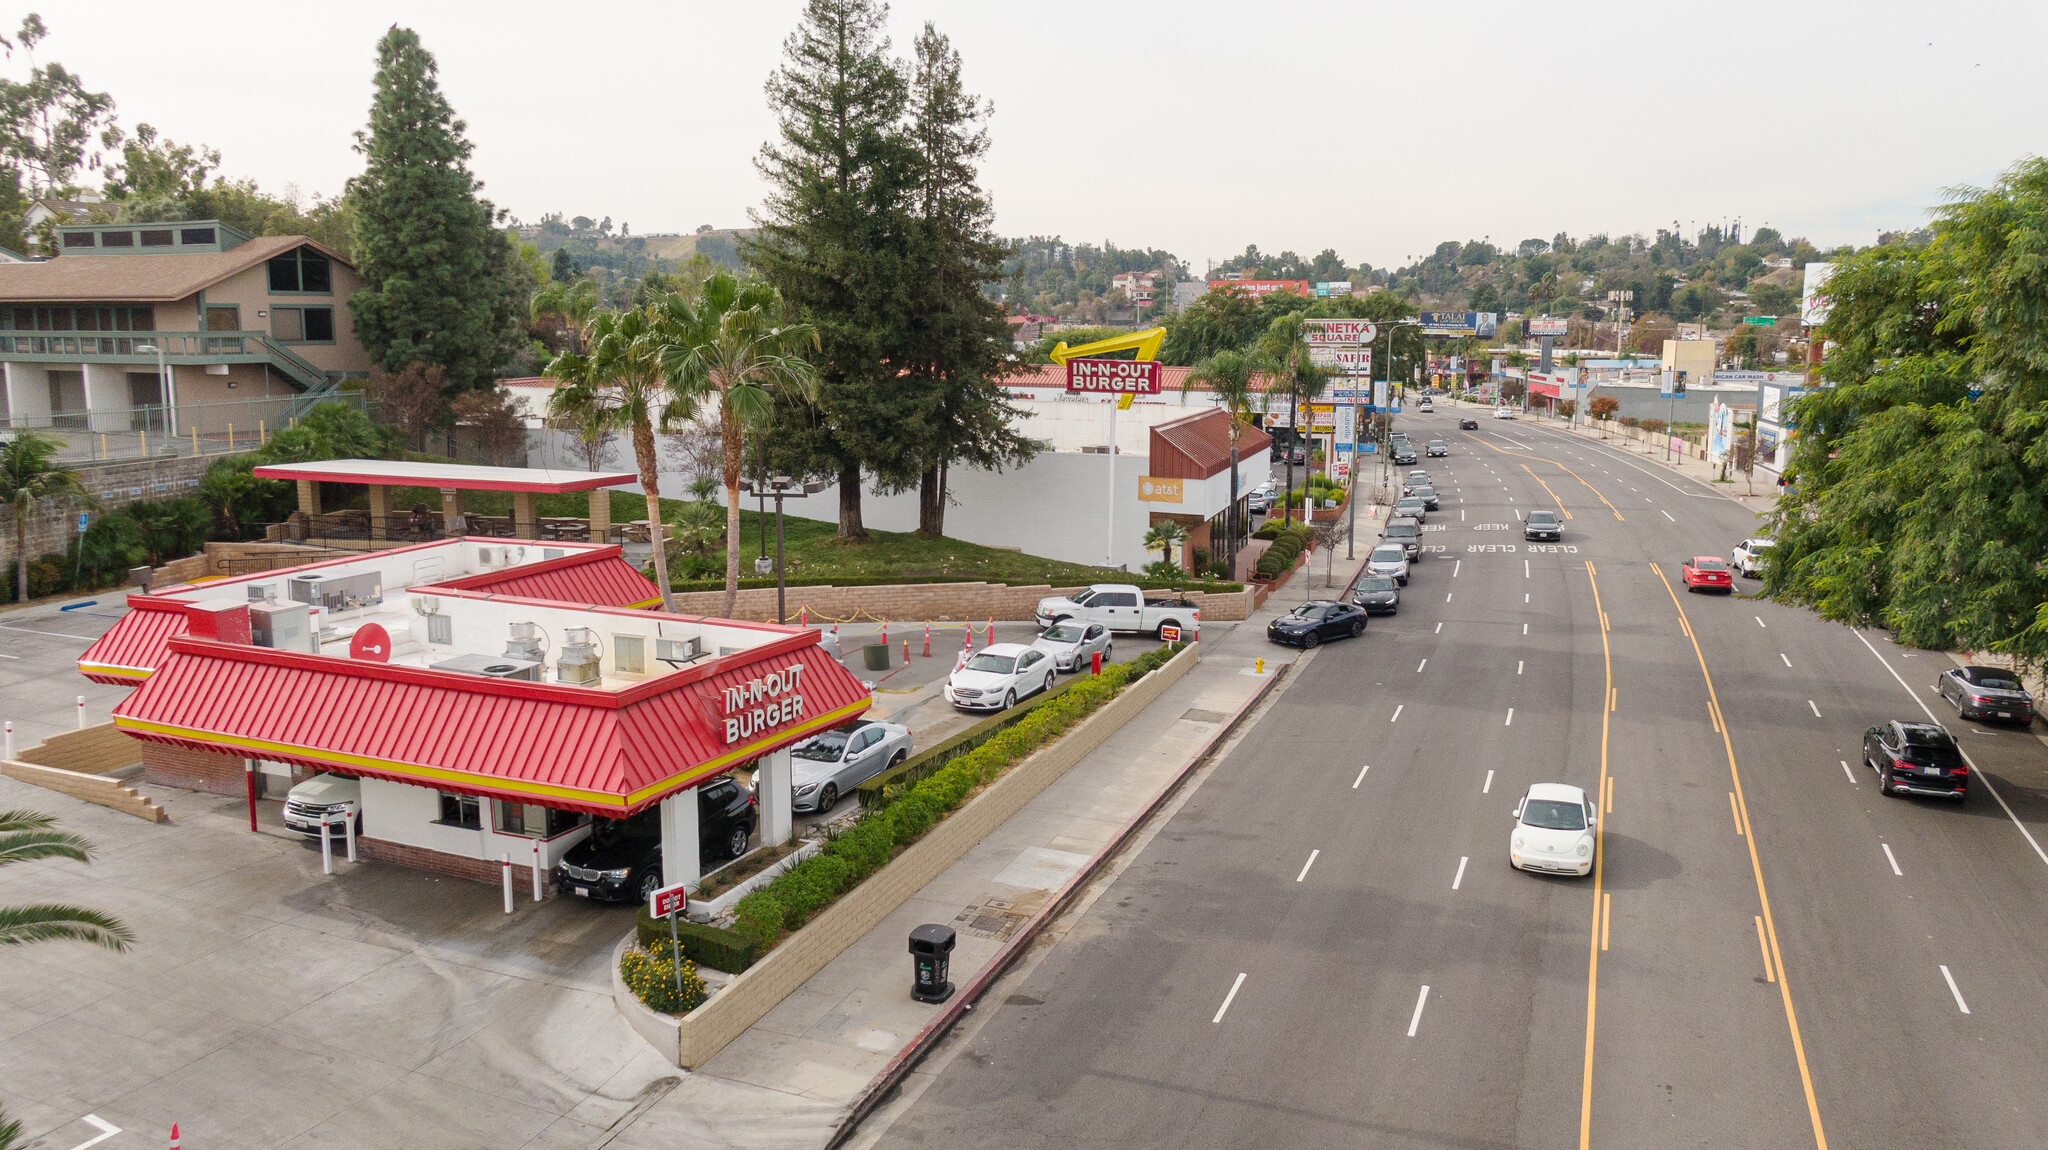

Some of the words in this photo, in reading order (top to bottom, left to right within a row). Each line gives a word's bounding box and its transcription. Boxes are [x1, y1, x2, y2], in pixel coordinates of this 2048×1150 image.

[1256, 283, 1270, 292] just
[1440, 312, 1465, 320] TALAI
[1311, 334, 1359, 342] SQUARE
[1336, 354, 1370, 363] SAFIR
[1072, 362, 1152, 378] IN-N-OUT
[1072, 376, 1150, 391] BURGER
[1155, 484, 1178, 496] at&t
[1421, 545, 1445, 553] CLE
[1467, 545, 1516, 553] CLEAR
[1528, 545, 1578, 553] CLEAR
[721, 664, 804, 714] IN-N-OUT
[722, 694, 804, 744] BURGER
[662, 897, 670, 905] DO
[663, 901, 680, 911] ENER
